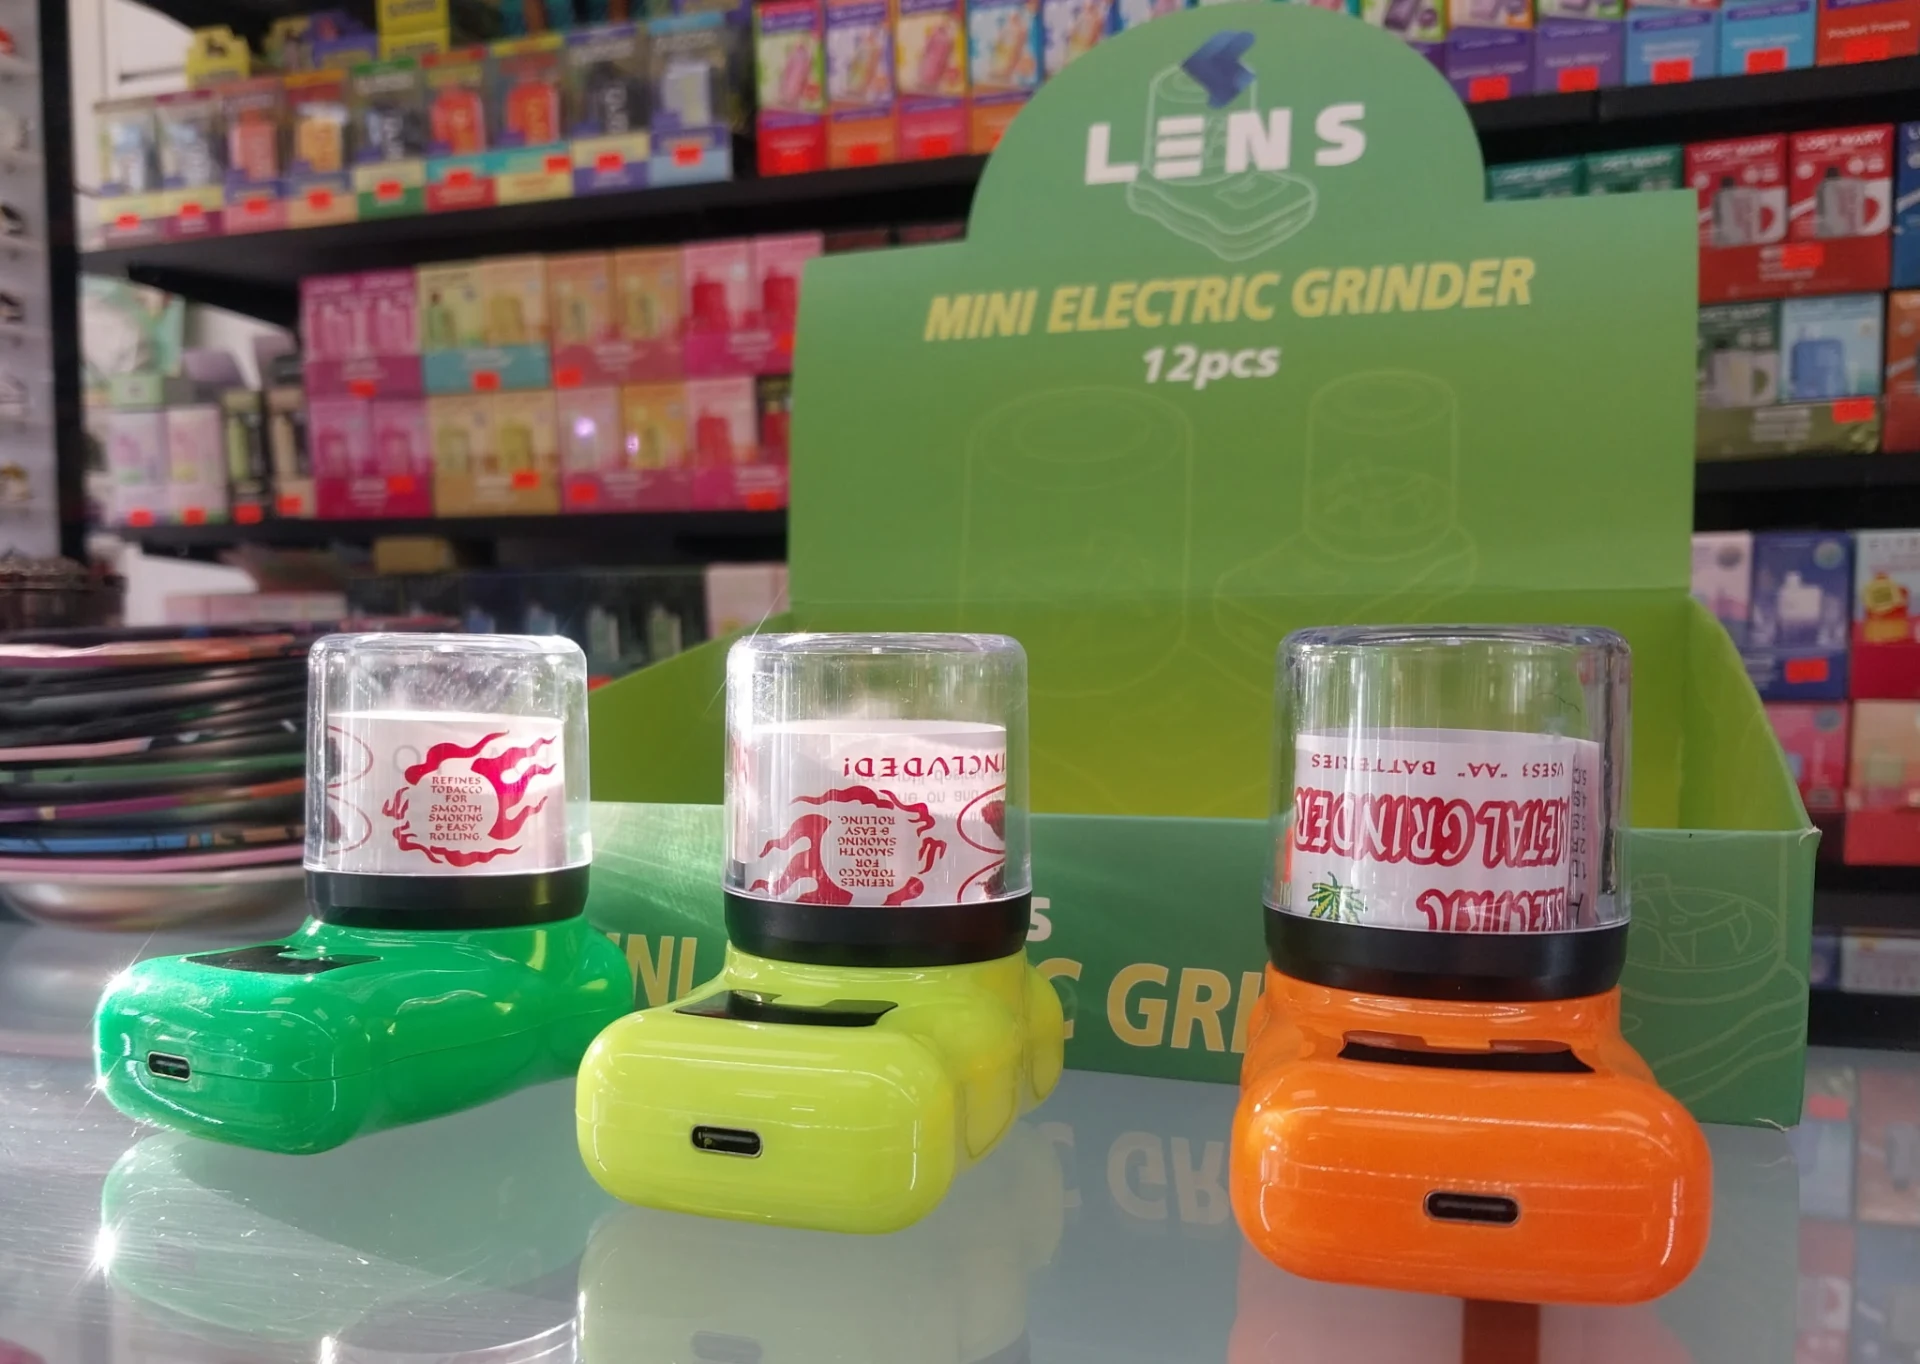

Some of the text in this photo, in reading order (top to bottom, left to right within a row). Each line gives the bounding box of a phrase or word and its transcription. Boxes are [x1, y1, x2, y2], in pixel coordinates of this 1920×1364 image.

[1085, 103, 1367, 186] LENS
[923, 258, 1536, 342] MINI ELECTRIC GRINDER
[1141, 345, 1282, 391] 12pcs
[1311, 753, 1436, 776] BATTERIES
[432, 776, 481, 785] REFINES
[430, 785, 483, 794] TOBACCO
[445, 794, 467, 803] FOR
[431, 804, 482, 813] SMOOTH
[428, 813, 483, 823] SMOKING
[837, 815, 896, 826] ROLLING.
[435, 823, 476, 832] & EASY
[845, 826, 890, 837] & EASY
[1293, 785, 1476, 868] GRINDER
[429, 832, 482, 842] ROLLING.
[837, 837, 897, 847] SMOKING
[839, 847, 894, 857] SMOOTH
[855, 858, 880, 868] FOR
[838, 868, 896, 878] TOBACCO
[841, 877, 895, 888] REFINES
